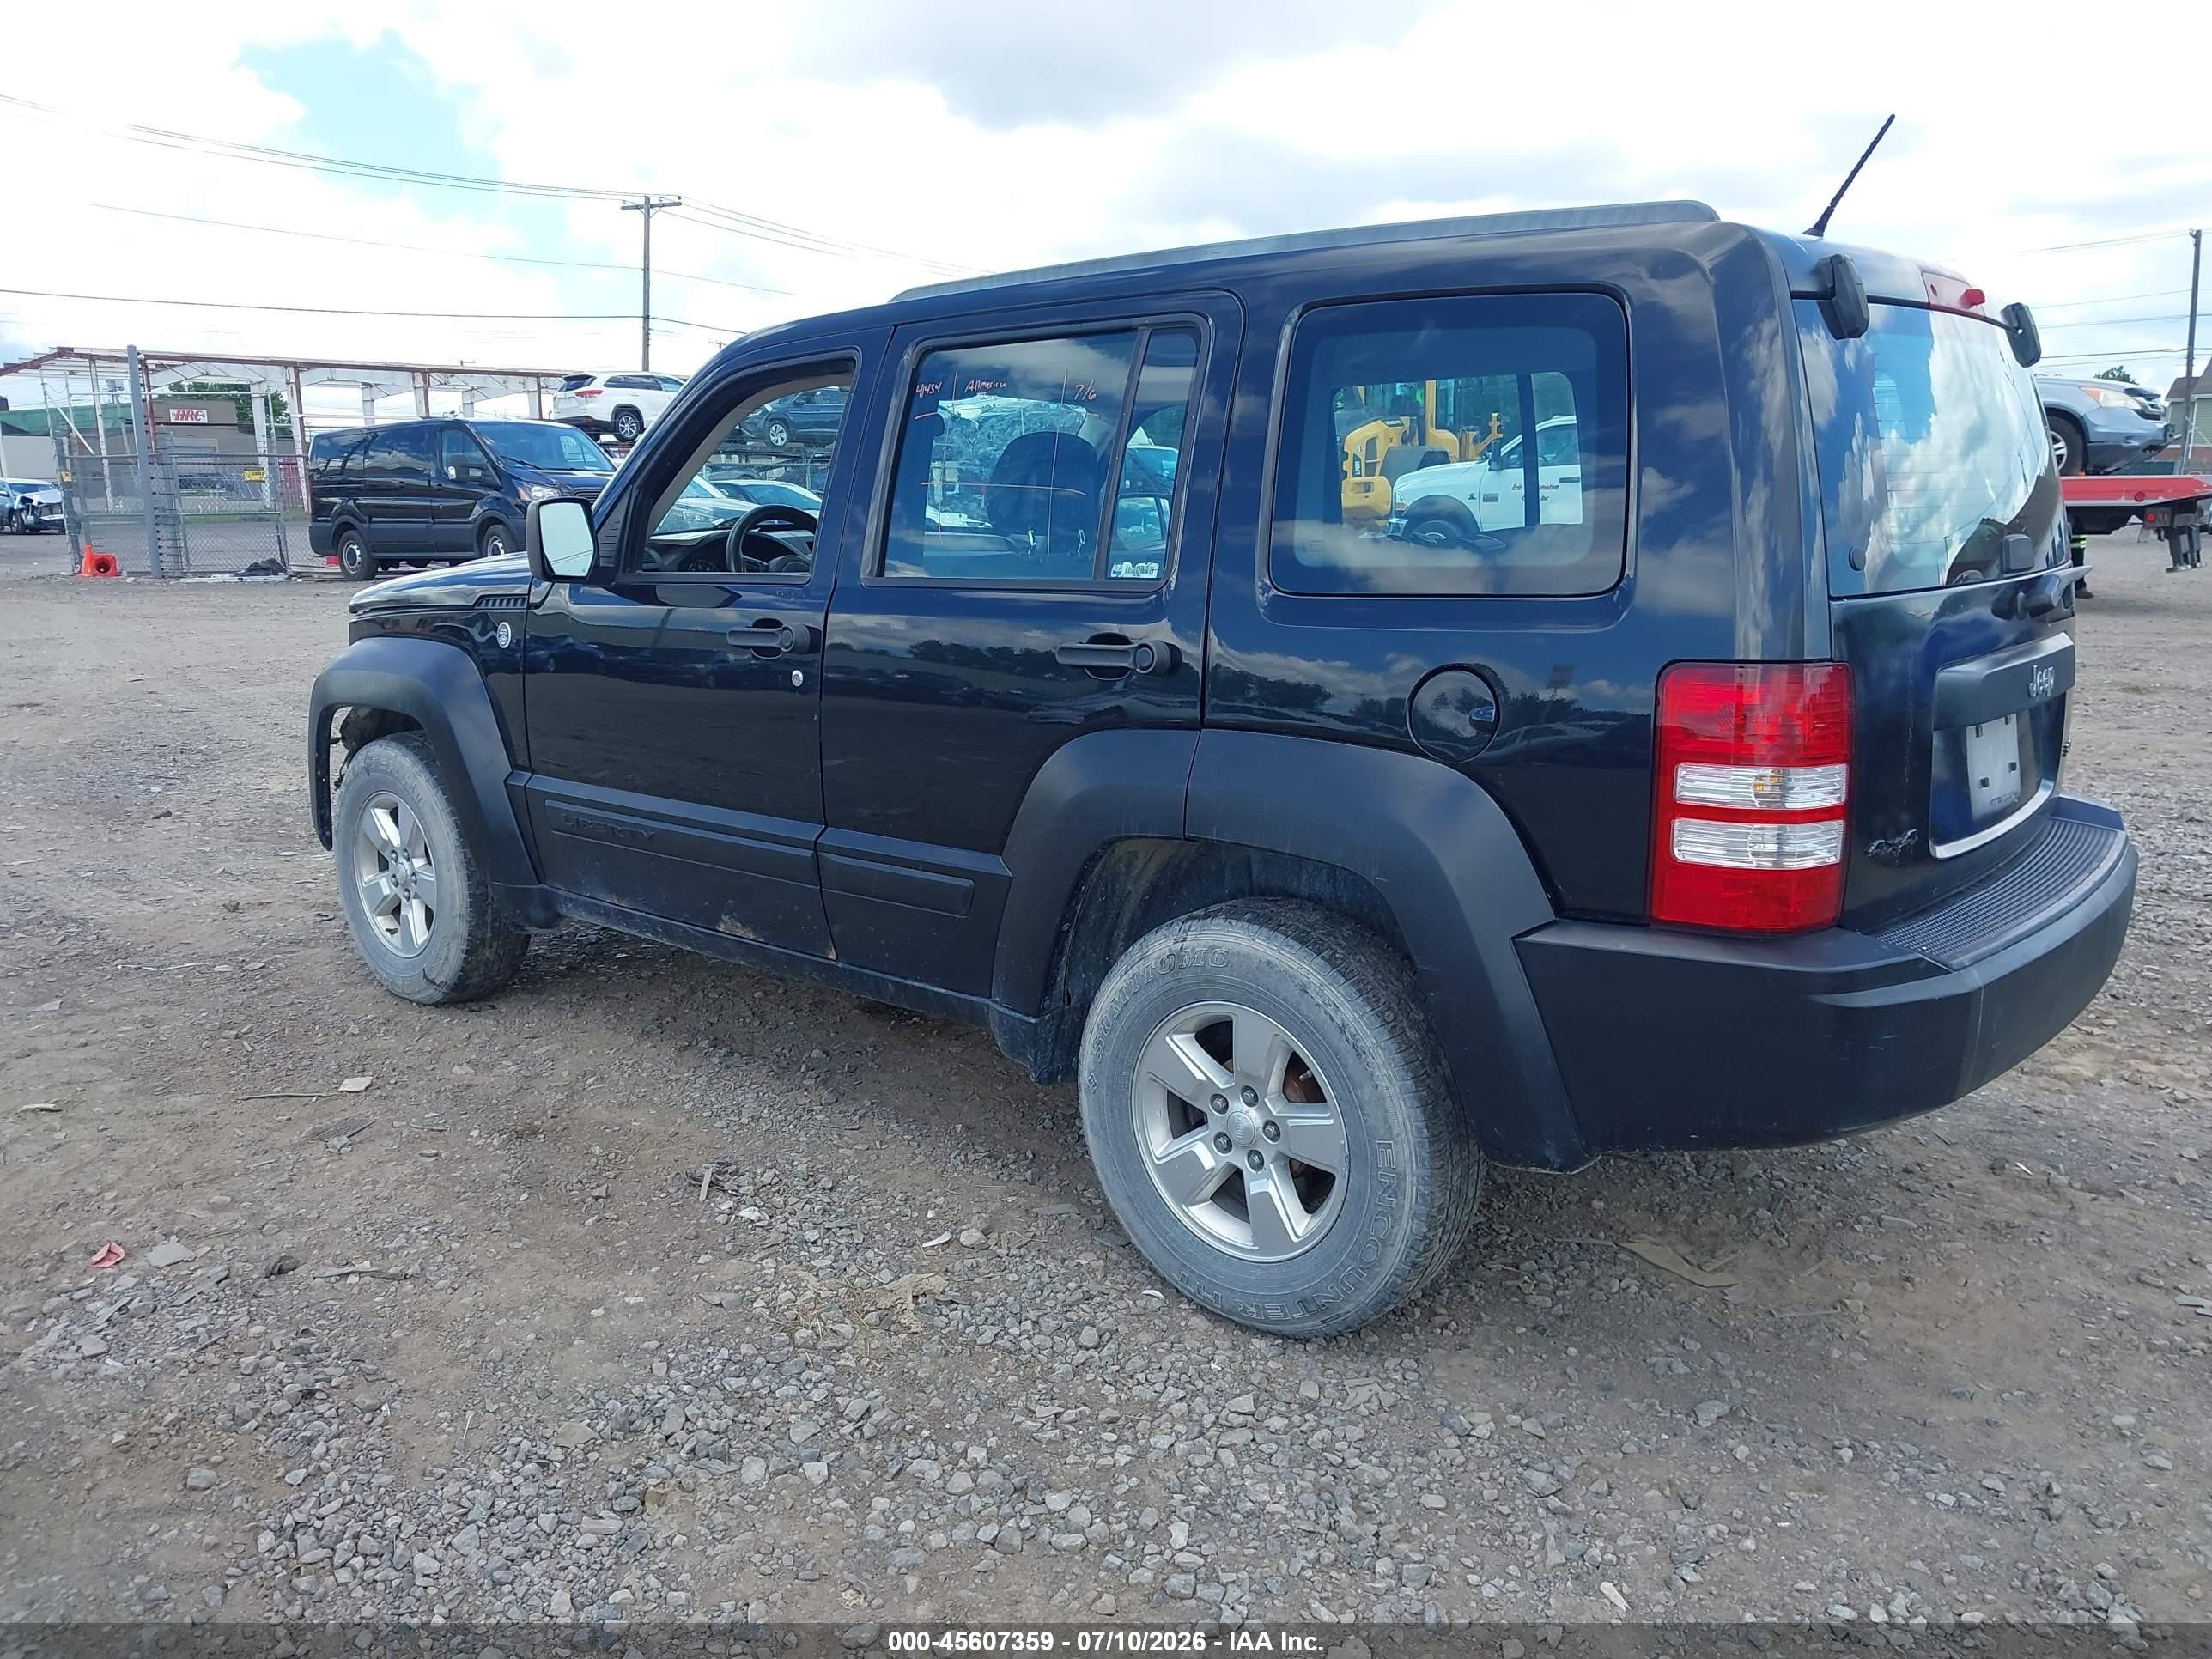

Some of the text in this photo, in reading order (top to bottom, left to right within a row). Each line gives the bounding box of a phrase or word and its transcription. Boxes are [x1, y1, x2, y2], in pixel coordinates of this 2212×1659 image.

[174, 410, 203, 421] HRC
[2029, 665, 2054, 698] Jeep
[1091, 948, 1231, 1063] SUMITOMO
[1235, 1139, 1396, 1321] ENCOUNTER
